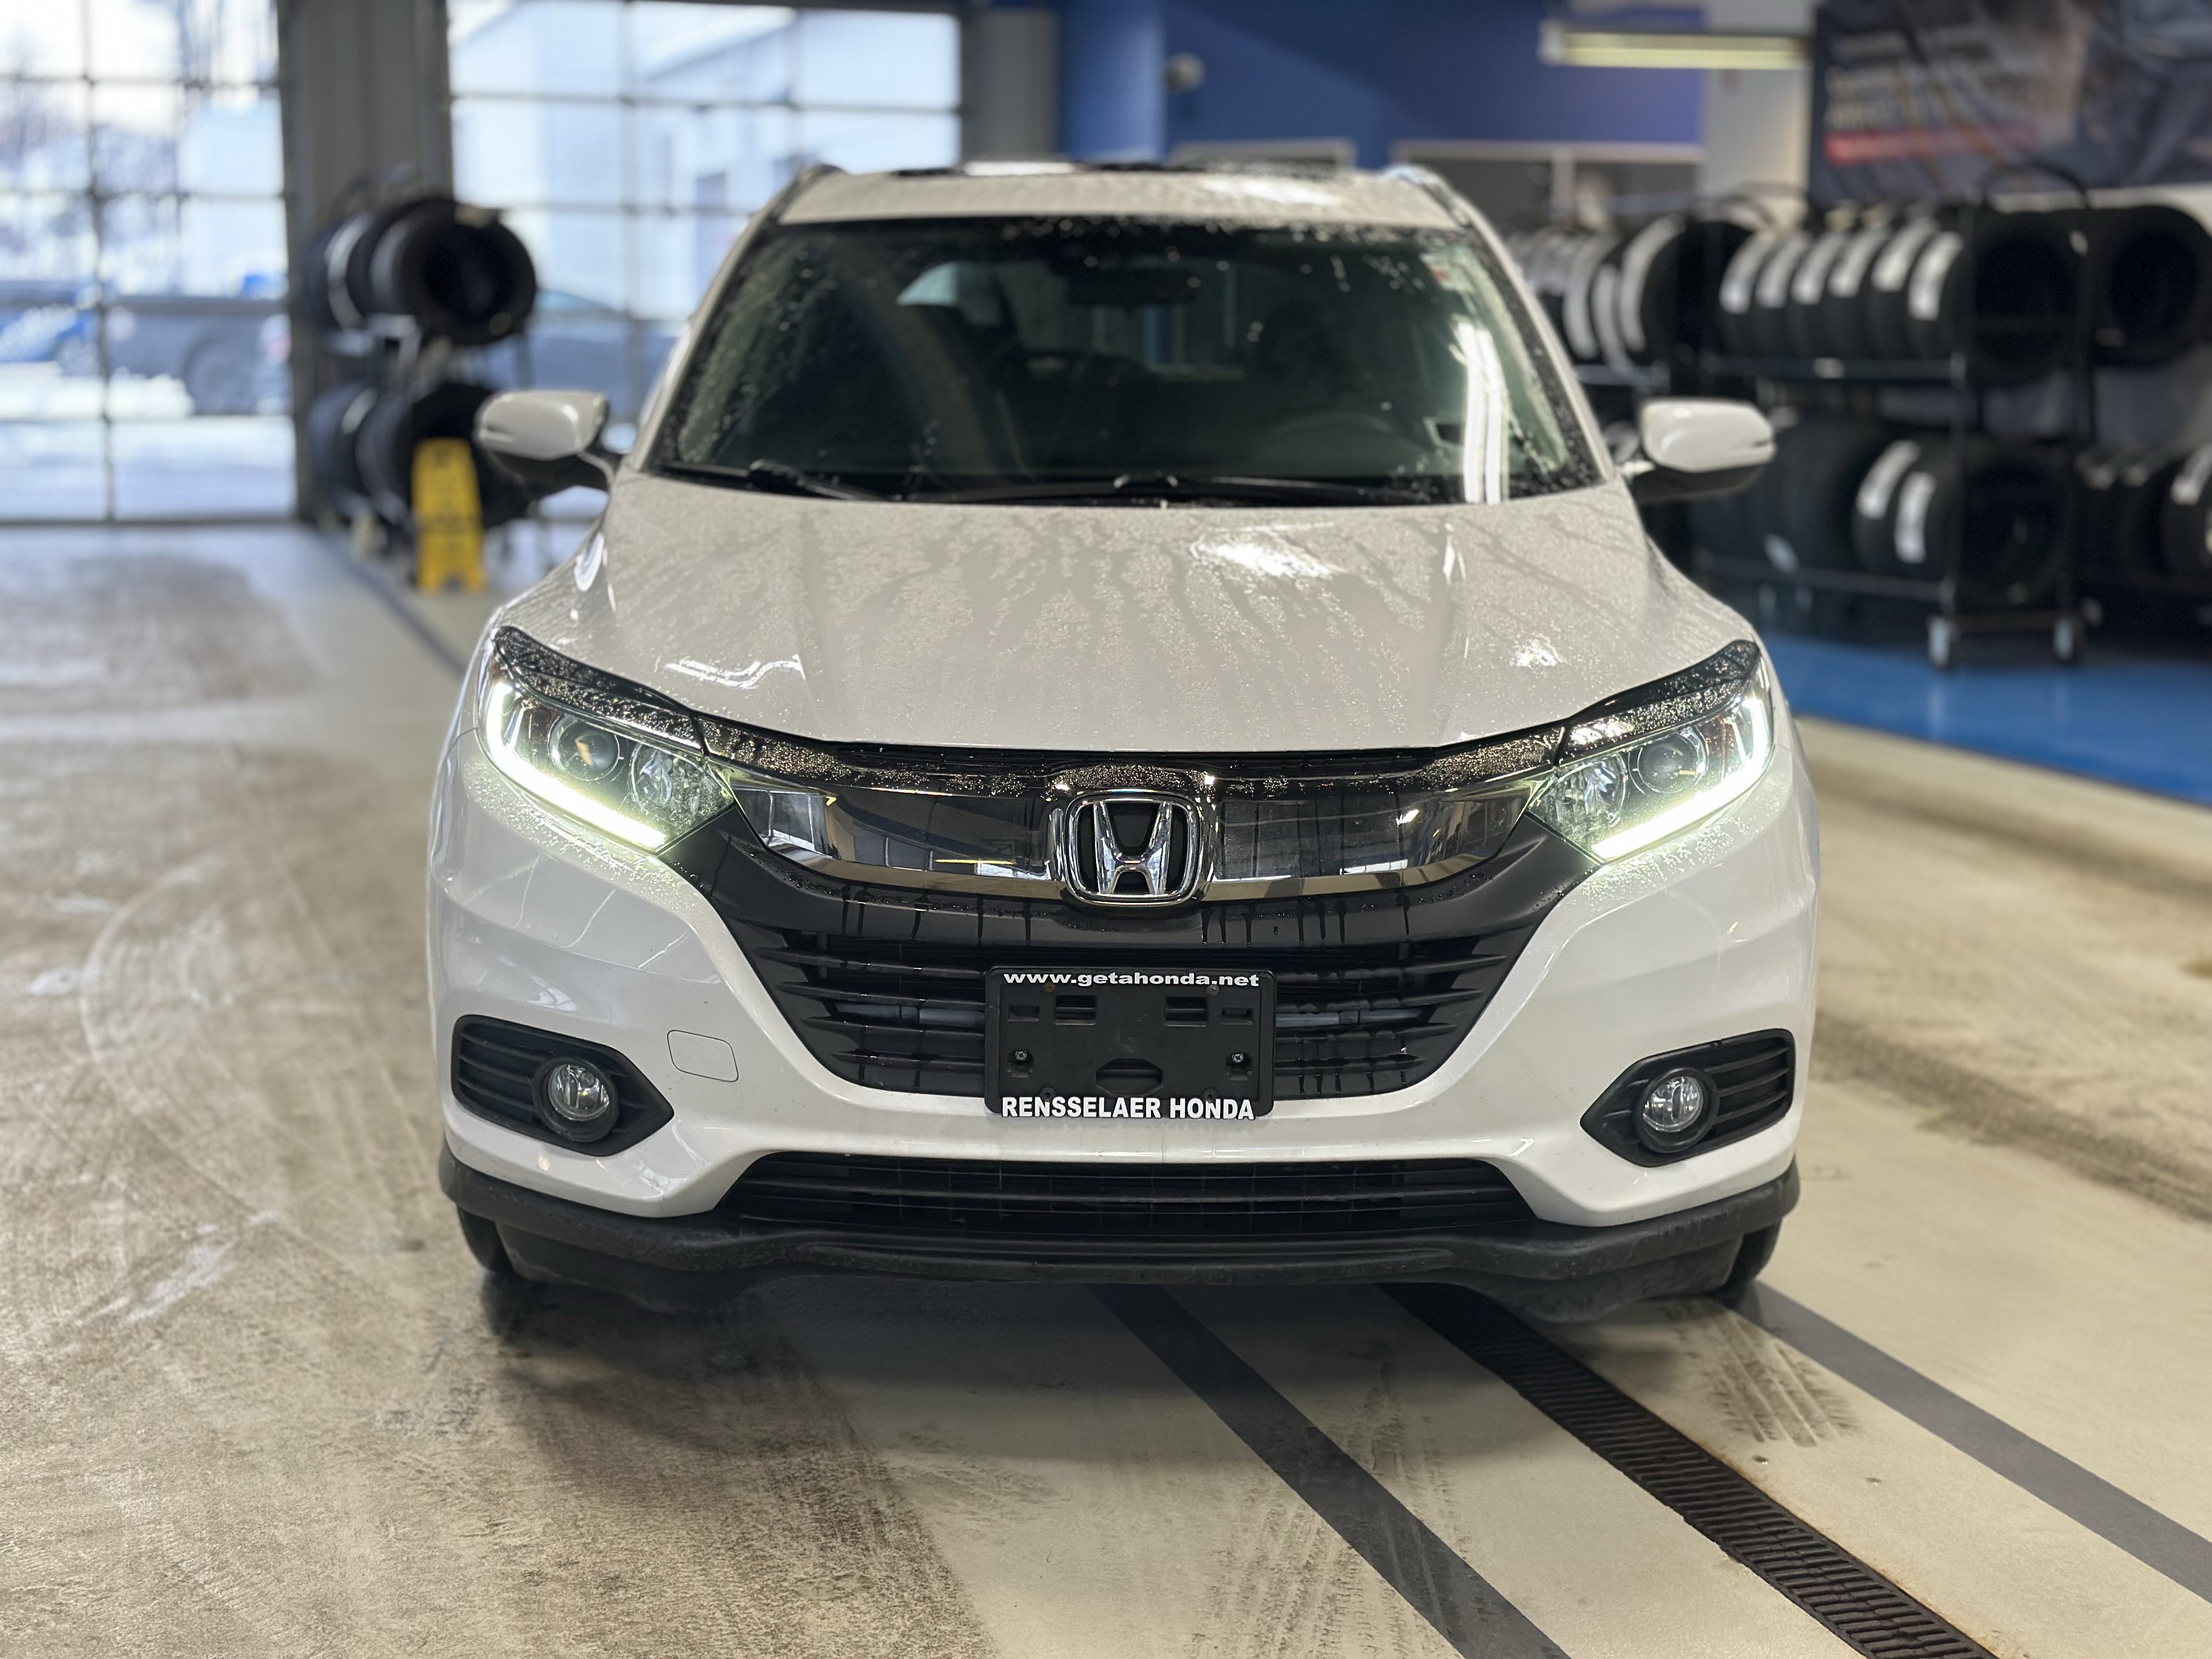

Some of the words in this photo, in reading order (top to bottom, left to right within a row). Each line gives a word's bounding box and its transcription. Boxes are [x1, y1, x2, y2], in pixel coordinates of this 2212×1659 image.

[1003, 972, 1260, 987] www.getahonda.net
[1002, 1096, 1161, 1118] RENSSELAER
[1169, 1098, 1255, 1120] HONDA
